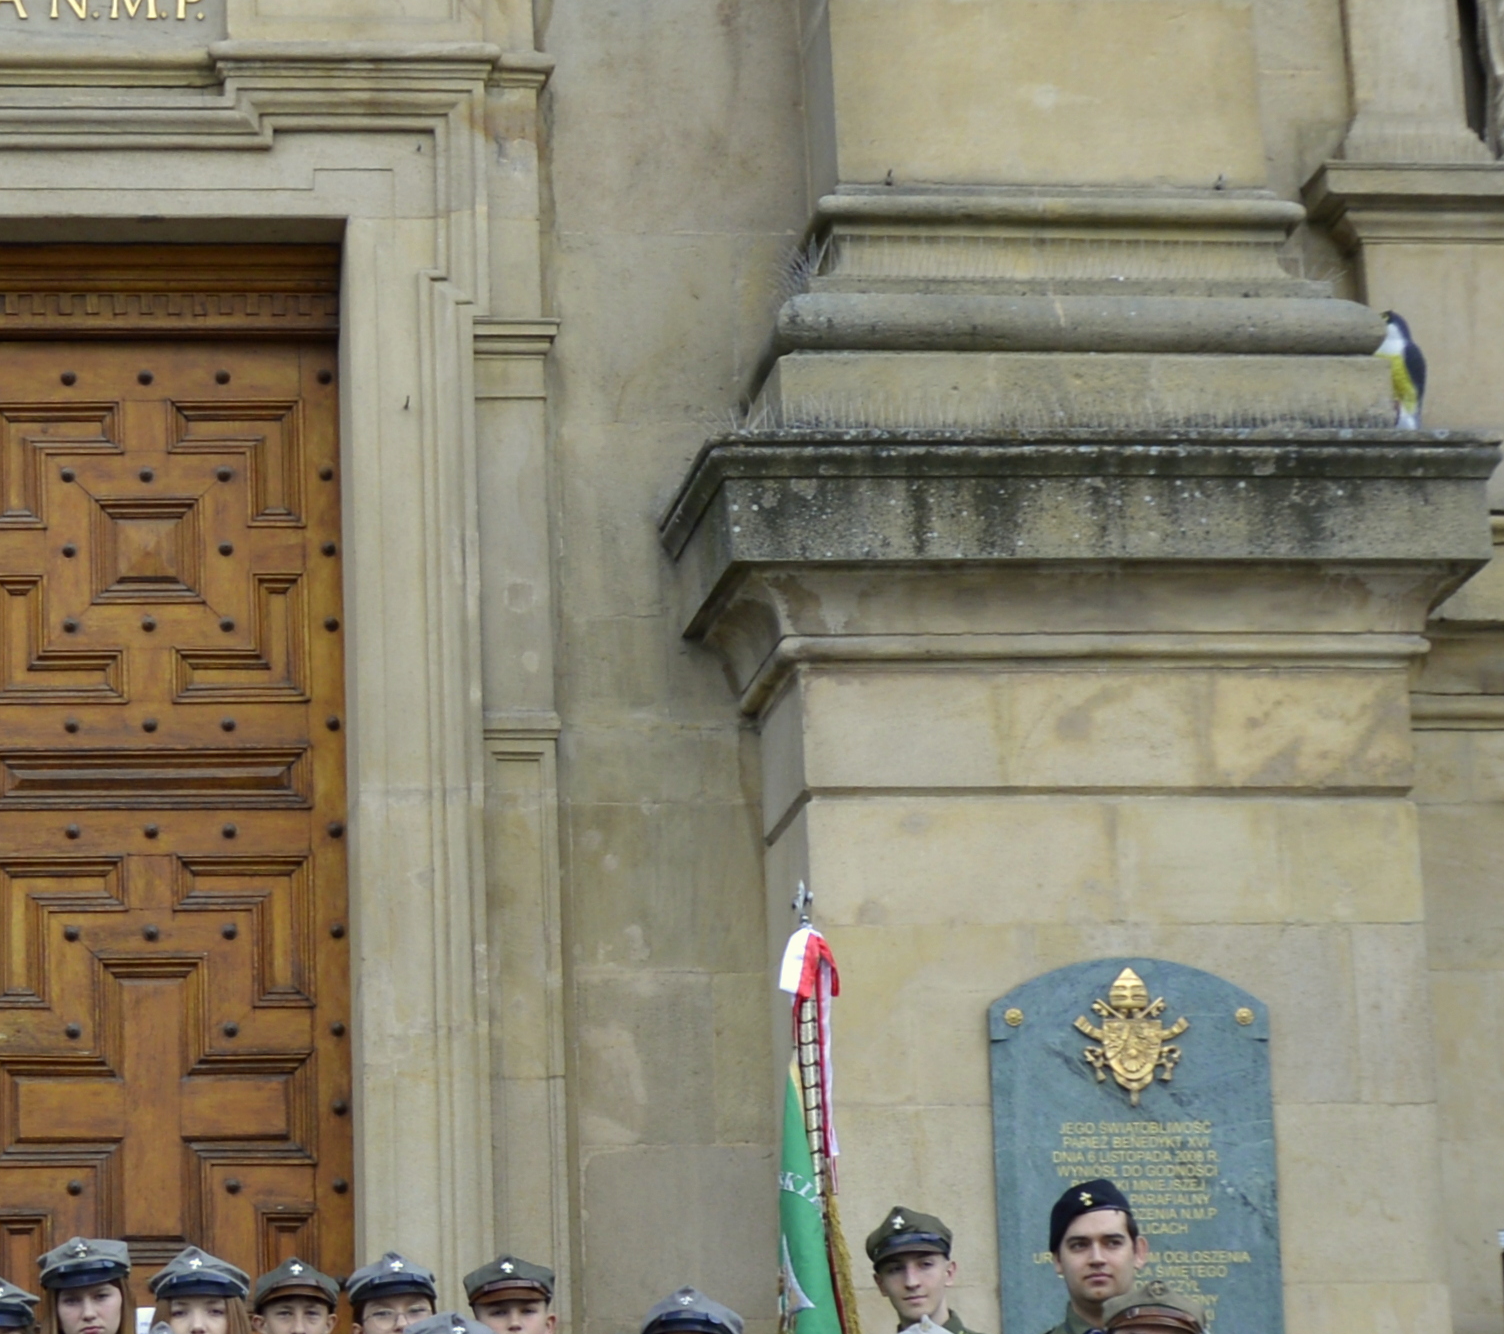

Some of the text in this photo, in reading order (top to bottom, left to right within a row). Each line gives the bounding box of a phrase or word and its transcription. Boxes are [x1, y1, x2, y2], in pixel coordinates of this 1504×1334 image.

[1059, 1122, 1095, 1134] JEGO
[1063, 1135, 1109, 1148] PAPIEŻ
[1112, 1136, 1182, 1148] BENEDYKT
[1052, 1151, 1085, 1163] DNIA
[1099, 1151, 1172, 1162] LISTOPADA
[1057, 1163, 1219, 1177] WYNIÓSŁ DO GODNOŚCI
[1133, 1180, 1206, 1191] MNIEJSZEJ
[1129, 1193, 1212, 1205] PARAFIALNY
[1165, 1251, 1251, 1264] OGŁOSZENIA
[1156, 1264, 1228, 1280] ŚWIĘTEGO
